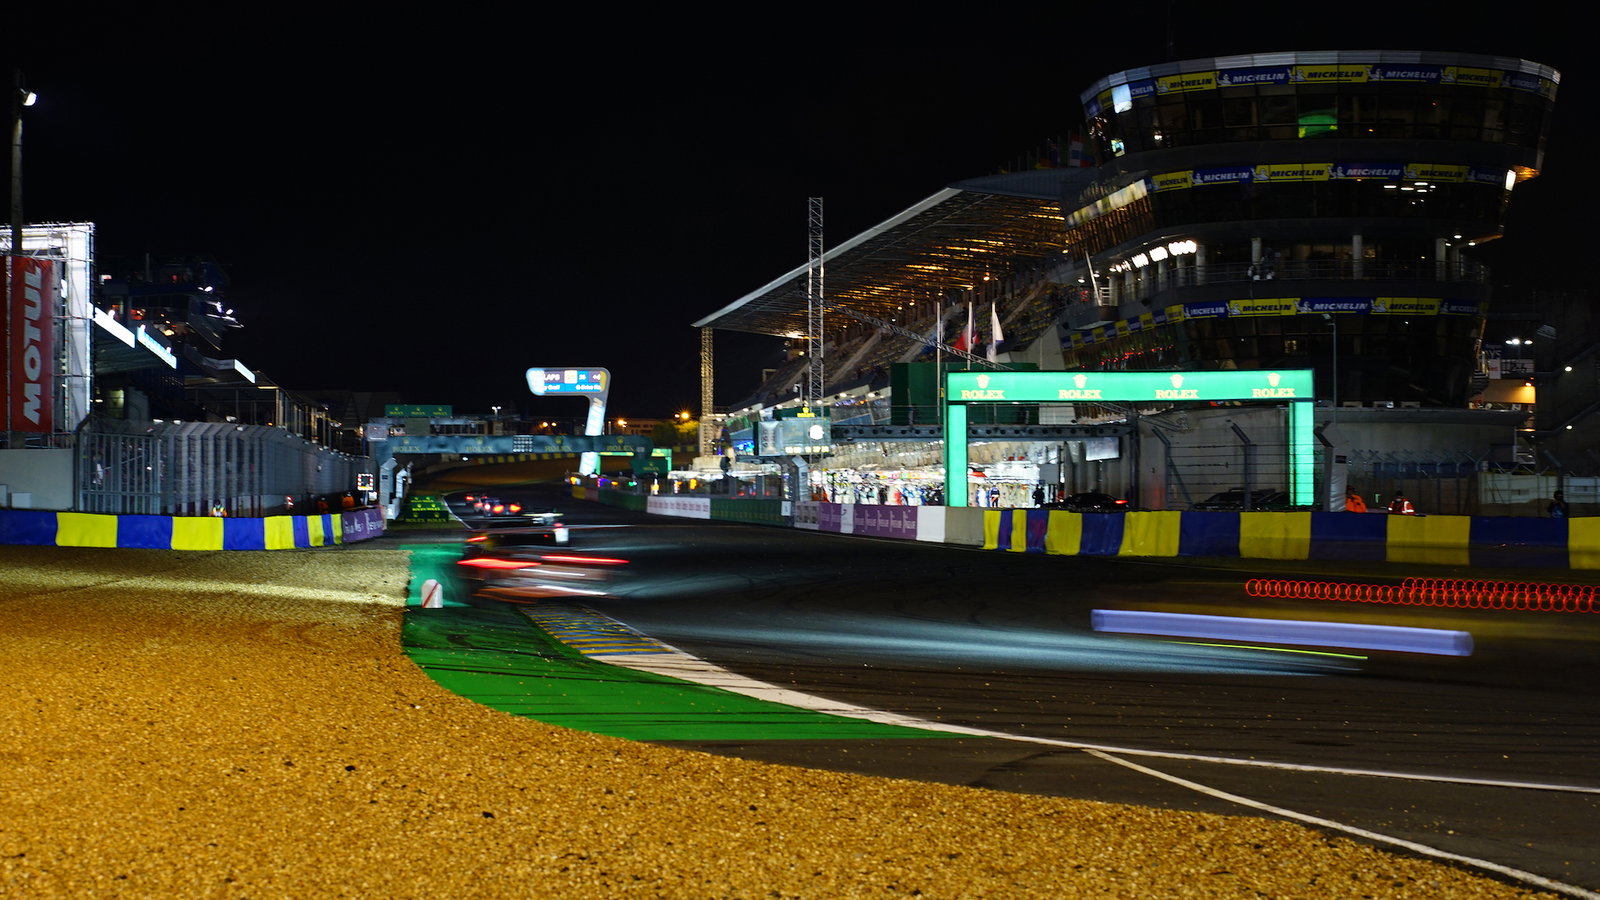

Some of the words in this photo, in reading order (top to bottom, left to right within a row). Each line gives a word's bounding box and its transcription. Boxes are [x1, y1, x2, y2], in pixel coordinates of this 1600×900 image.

[1232, 73, 1286, 83] MICHELIN
[1307, 71, 1364, 79] MICHELIN
[1386, 70, 1438, 79] MICHELIN
[1169, 79, 1212, 88] MICHELIN
[1203, 172, 1250, 182] MICHELIN
[1190, 307, 1226, 315] MICHELIN
[24, 265, 43, 425] MOTUL
[961, 389, 1006, 400] ROLEX
[1058, 389, 1102, 400] ROLEX
[1155, 389, 1200, 400] ROLEX
[1252, 388, 1295, 398] ROLEX
